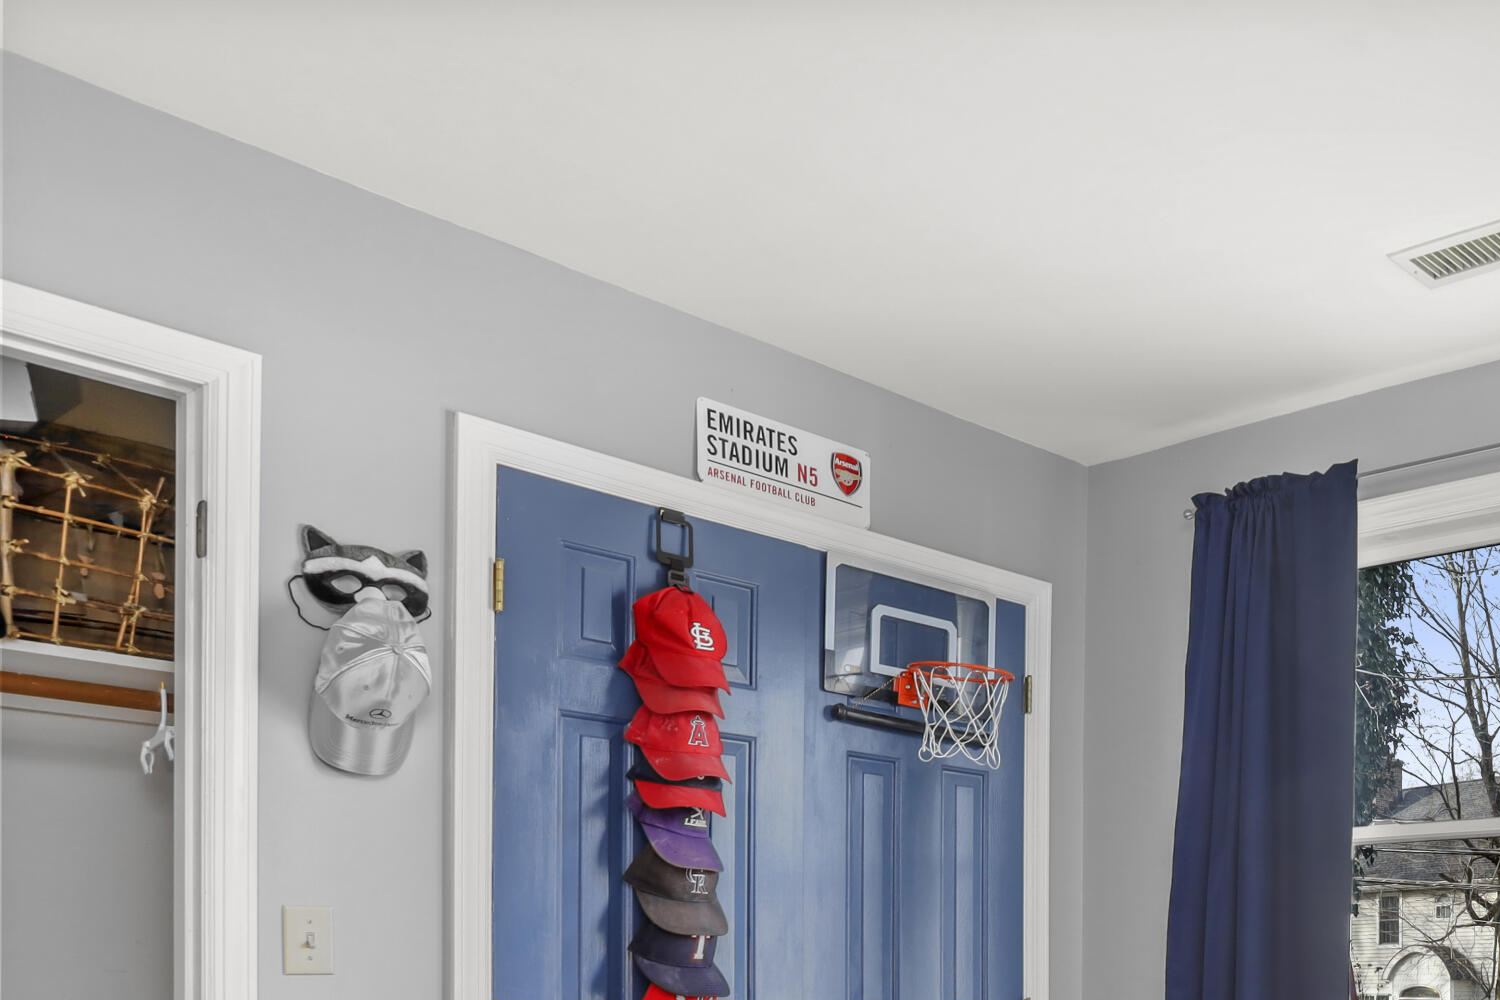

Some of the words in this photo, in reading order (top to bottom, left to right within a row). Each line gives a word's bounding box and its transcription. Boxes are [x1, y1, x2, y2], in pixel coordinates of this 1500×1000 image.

[706, 407, 798, 456] EMIRATES
[706, 434, 789, 479] STADIUM
[797, 463, 819, 488] N5
[707, 466, 747, 487] ARSENAL
[750, 477, 793, 500] FOOTBALL
[794, 491, 816, 507] CLUB
[688, 715, 710, 747] A
